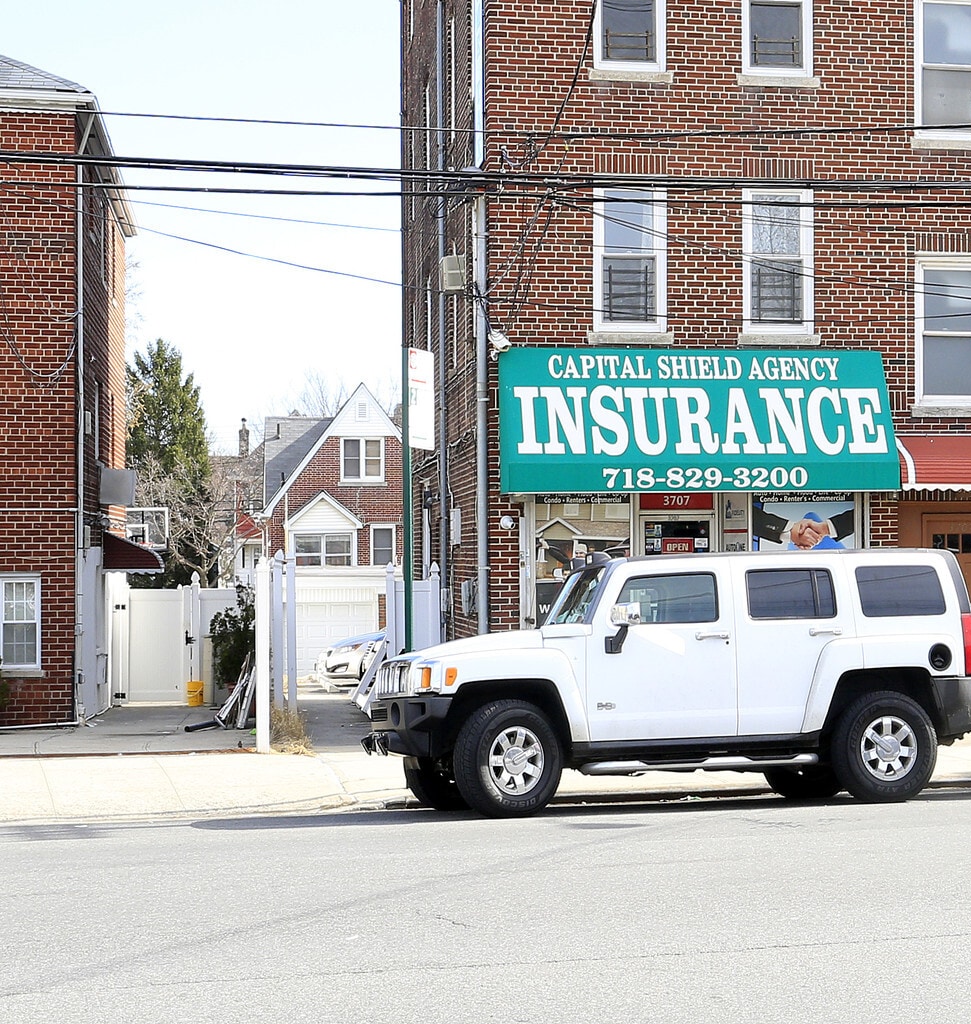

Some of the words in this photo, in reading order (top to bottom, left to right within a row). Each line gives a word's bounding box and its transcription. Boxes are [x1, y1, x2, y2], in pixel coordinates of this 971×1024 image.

[548, 354, 652, 380] CAPITAL
[658, 356, 742, 381] SHIELD
[748, 357, 840, 382] AGENCY
[513, 384, 889, 457] INSURANCE
[602, 466, 809, 489] 718-829-3200
[590, 495, 622, 503] Commercial
[663, 495, 690, 506] 3707
[759, 495, 779, 503] Condo
[812, 494, 846, 502] Commercial
[666, 542, 689, 552] OPEN
